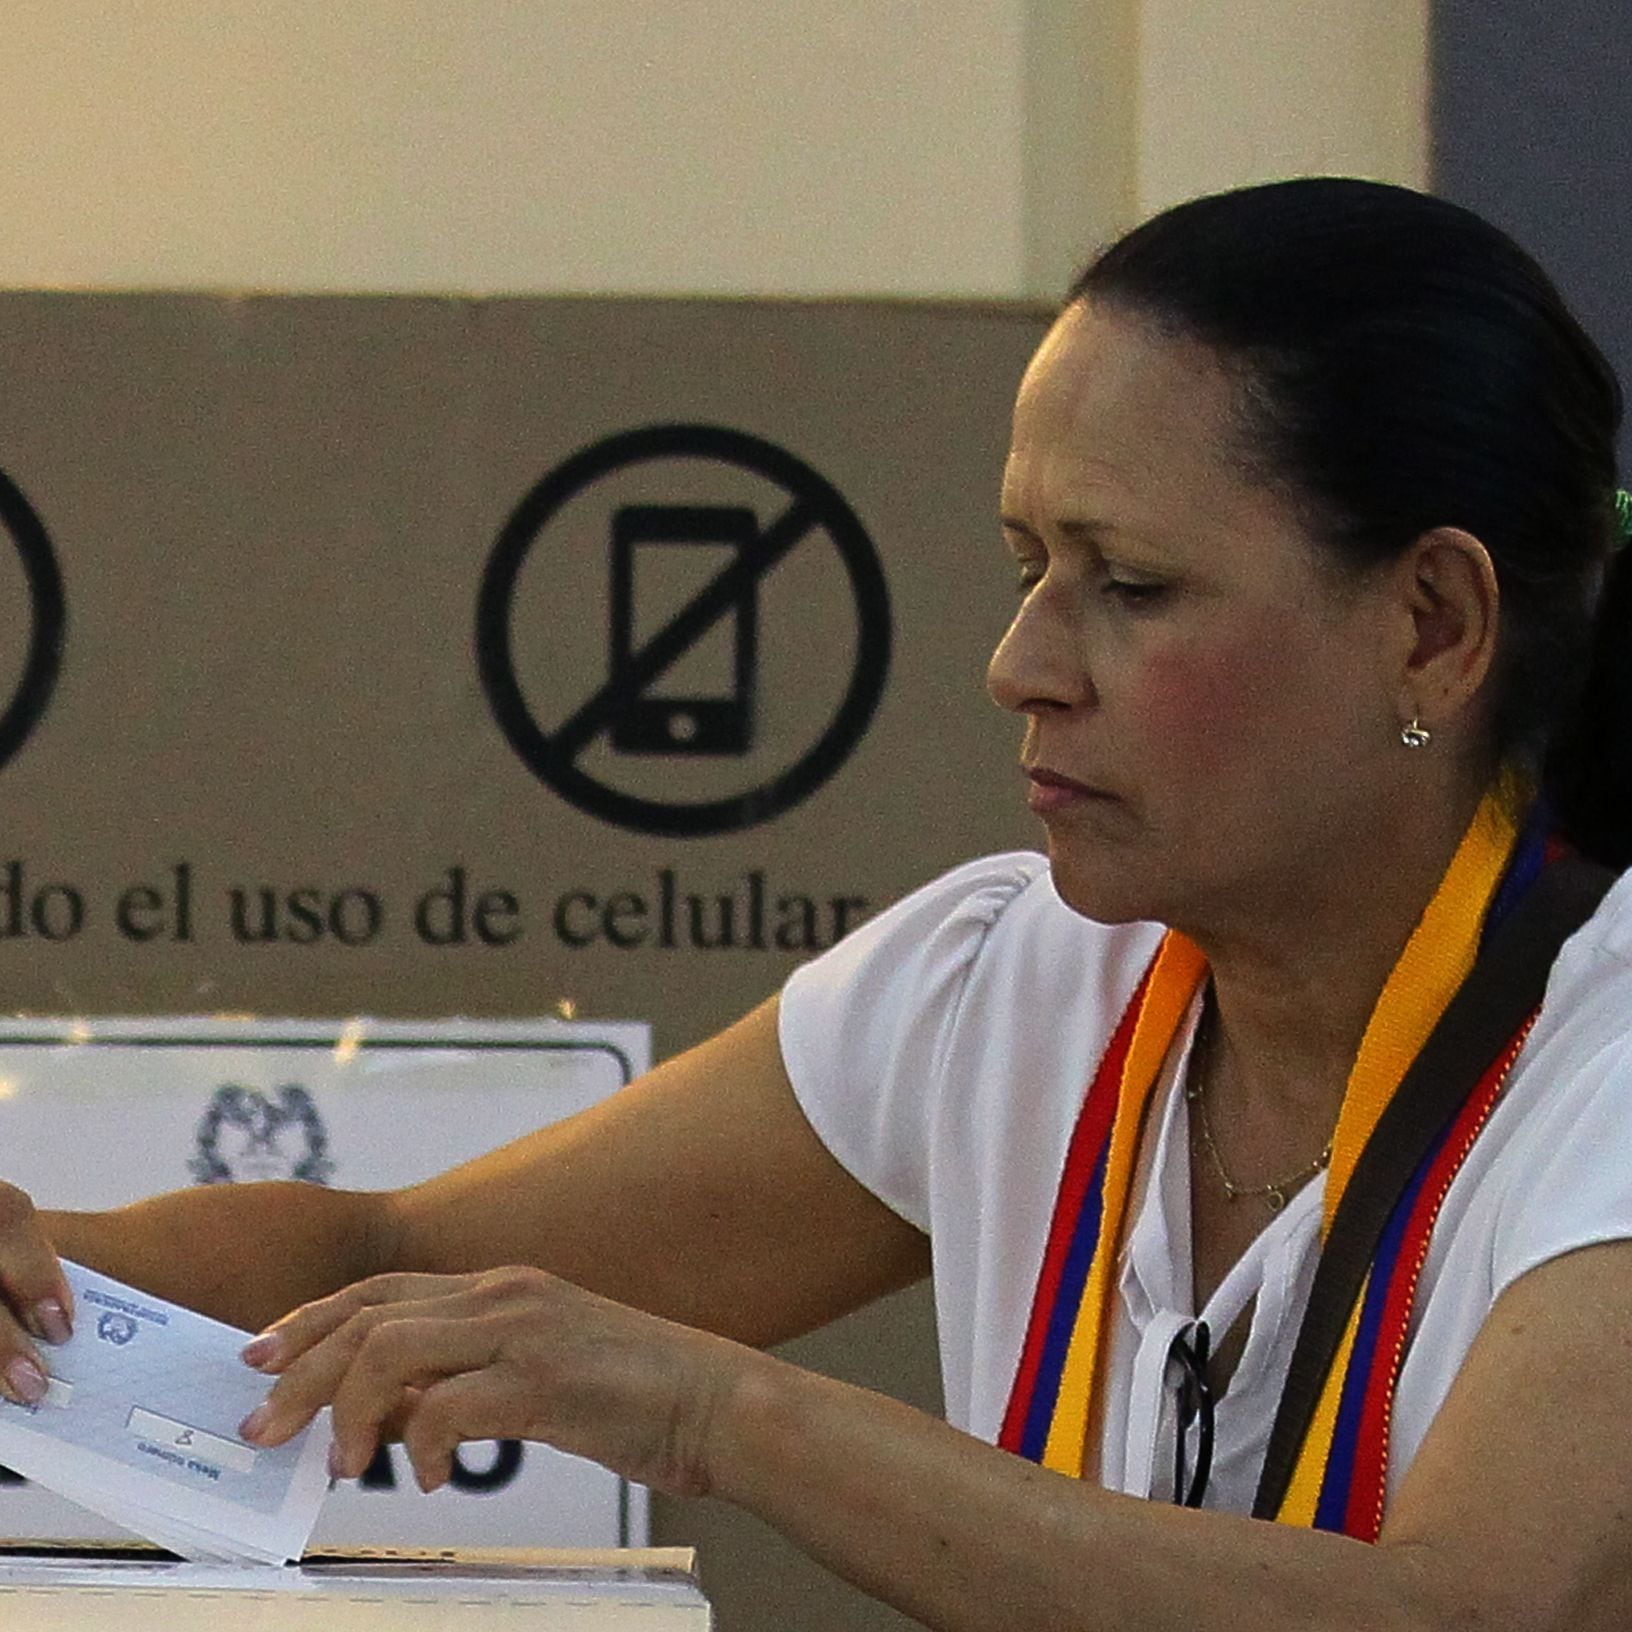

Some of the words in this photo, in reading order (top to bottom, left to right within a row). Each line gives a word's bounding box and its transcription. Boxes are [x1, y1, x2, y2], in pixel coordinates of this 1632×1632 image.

[115, 862, 192, 944] el
[230, 883, 380, 947] uso
[415, 866, 523, 949] de
[552, 867, 870, 951] celular
